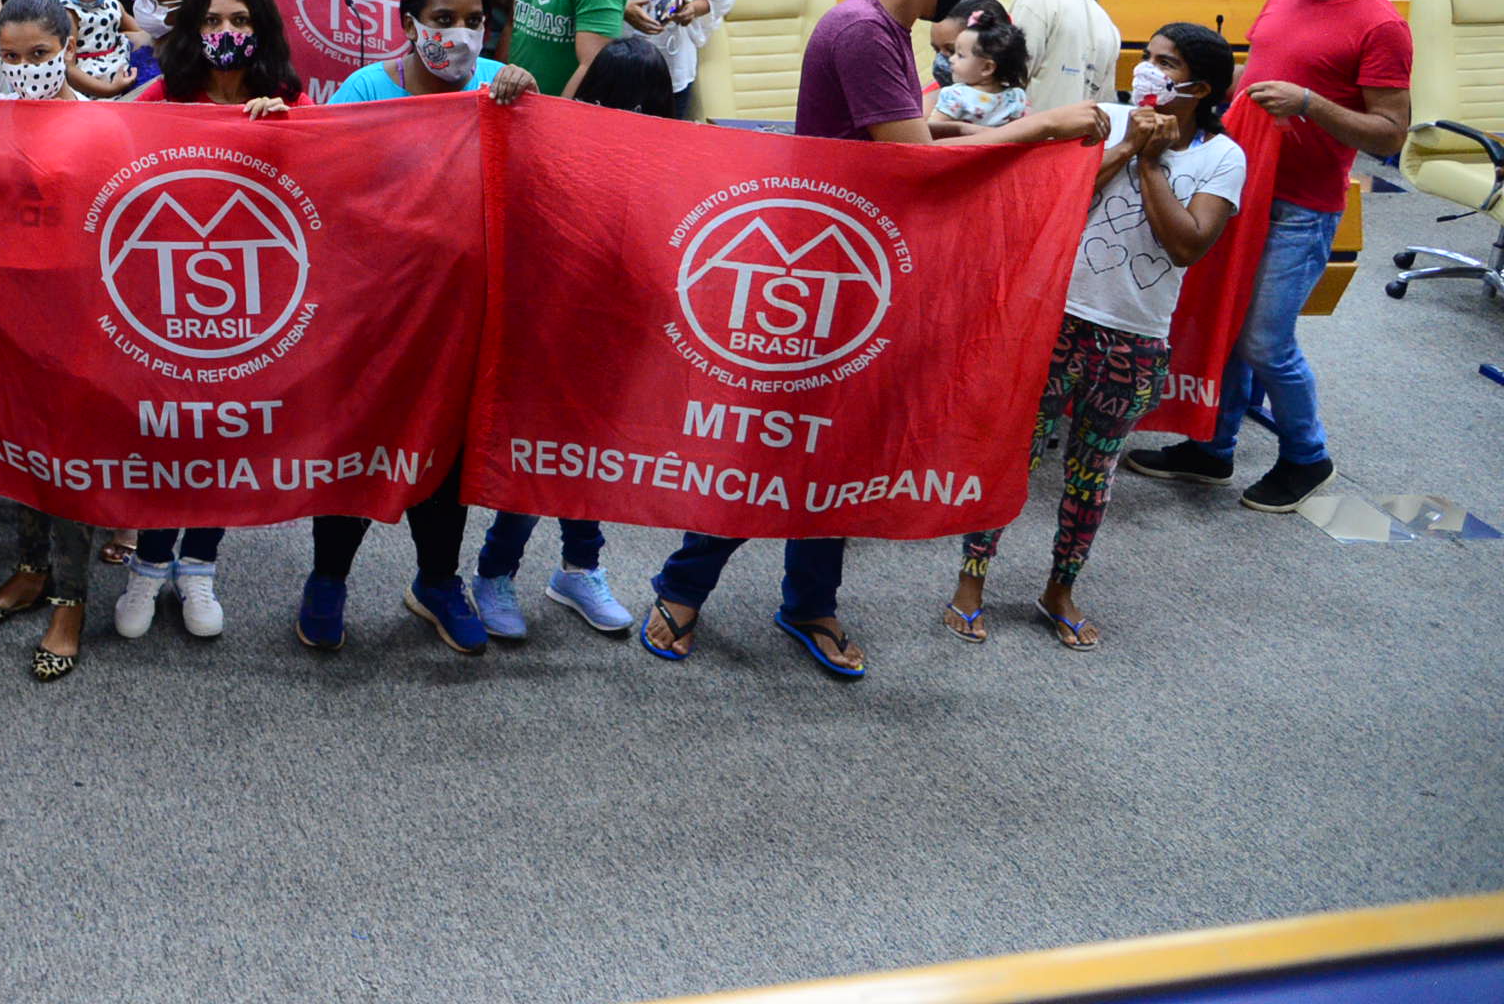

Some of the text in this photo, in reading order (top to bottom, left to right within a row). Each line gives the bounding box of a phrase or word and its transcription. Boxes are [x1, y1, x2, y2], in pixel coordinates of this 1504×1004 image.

[302, 27, 325, 52] LUTA
[324, 48, 351, 65] PELA
[332, 30, 390, 53] BRASIL
[83, 167, 132, 233] MOVIMENTO
[130, 153, 159, 173] DOS
[159, 146, 278, 178] TRABALHADORES
[277, 173, 304, 199] SEM
[299, 196, 322, 231] TETO
[668, 176, 913, 274] MOVIMENTO DOS TRABALHADORES SEM TETO
[97, 302, 319, 383] NA LUTA PELA REFORMA URBANA
[166, 317, 260, 339] BRASIL
[728, 331, 824, 359] BRASIL
[663, 321, 891, 393] NA LUTA PELA REFORMA URBANA
[138, 399, 283, 439] MTST
[681, 400, 832, 454] MTST
[510, 437, 983, 514] RESISTÊNCIA URBANA
